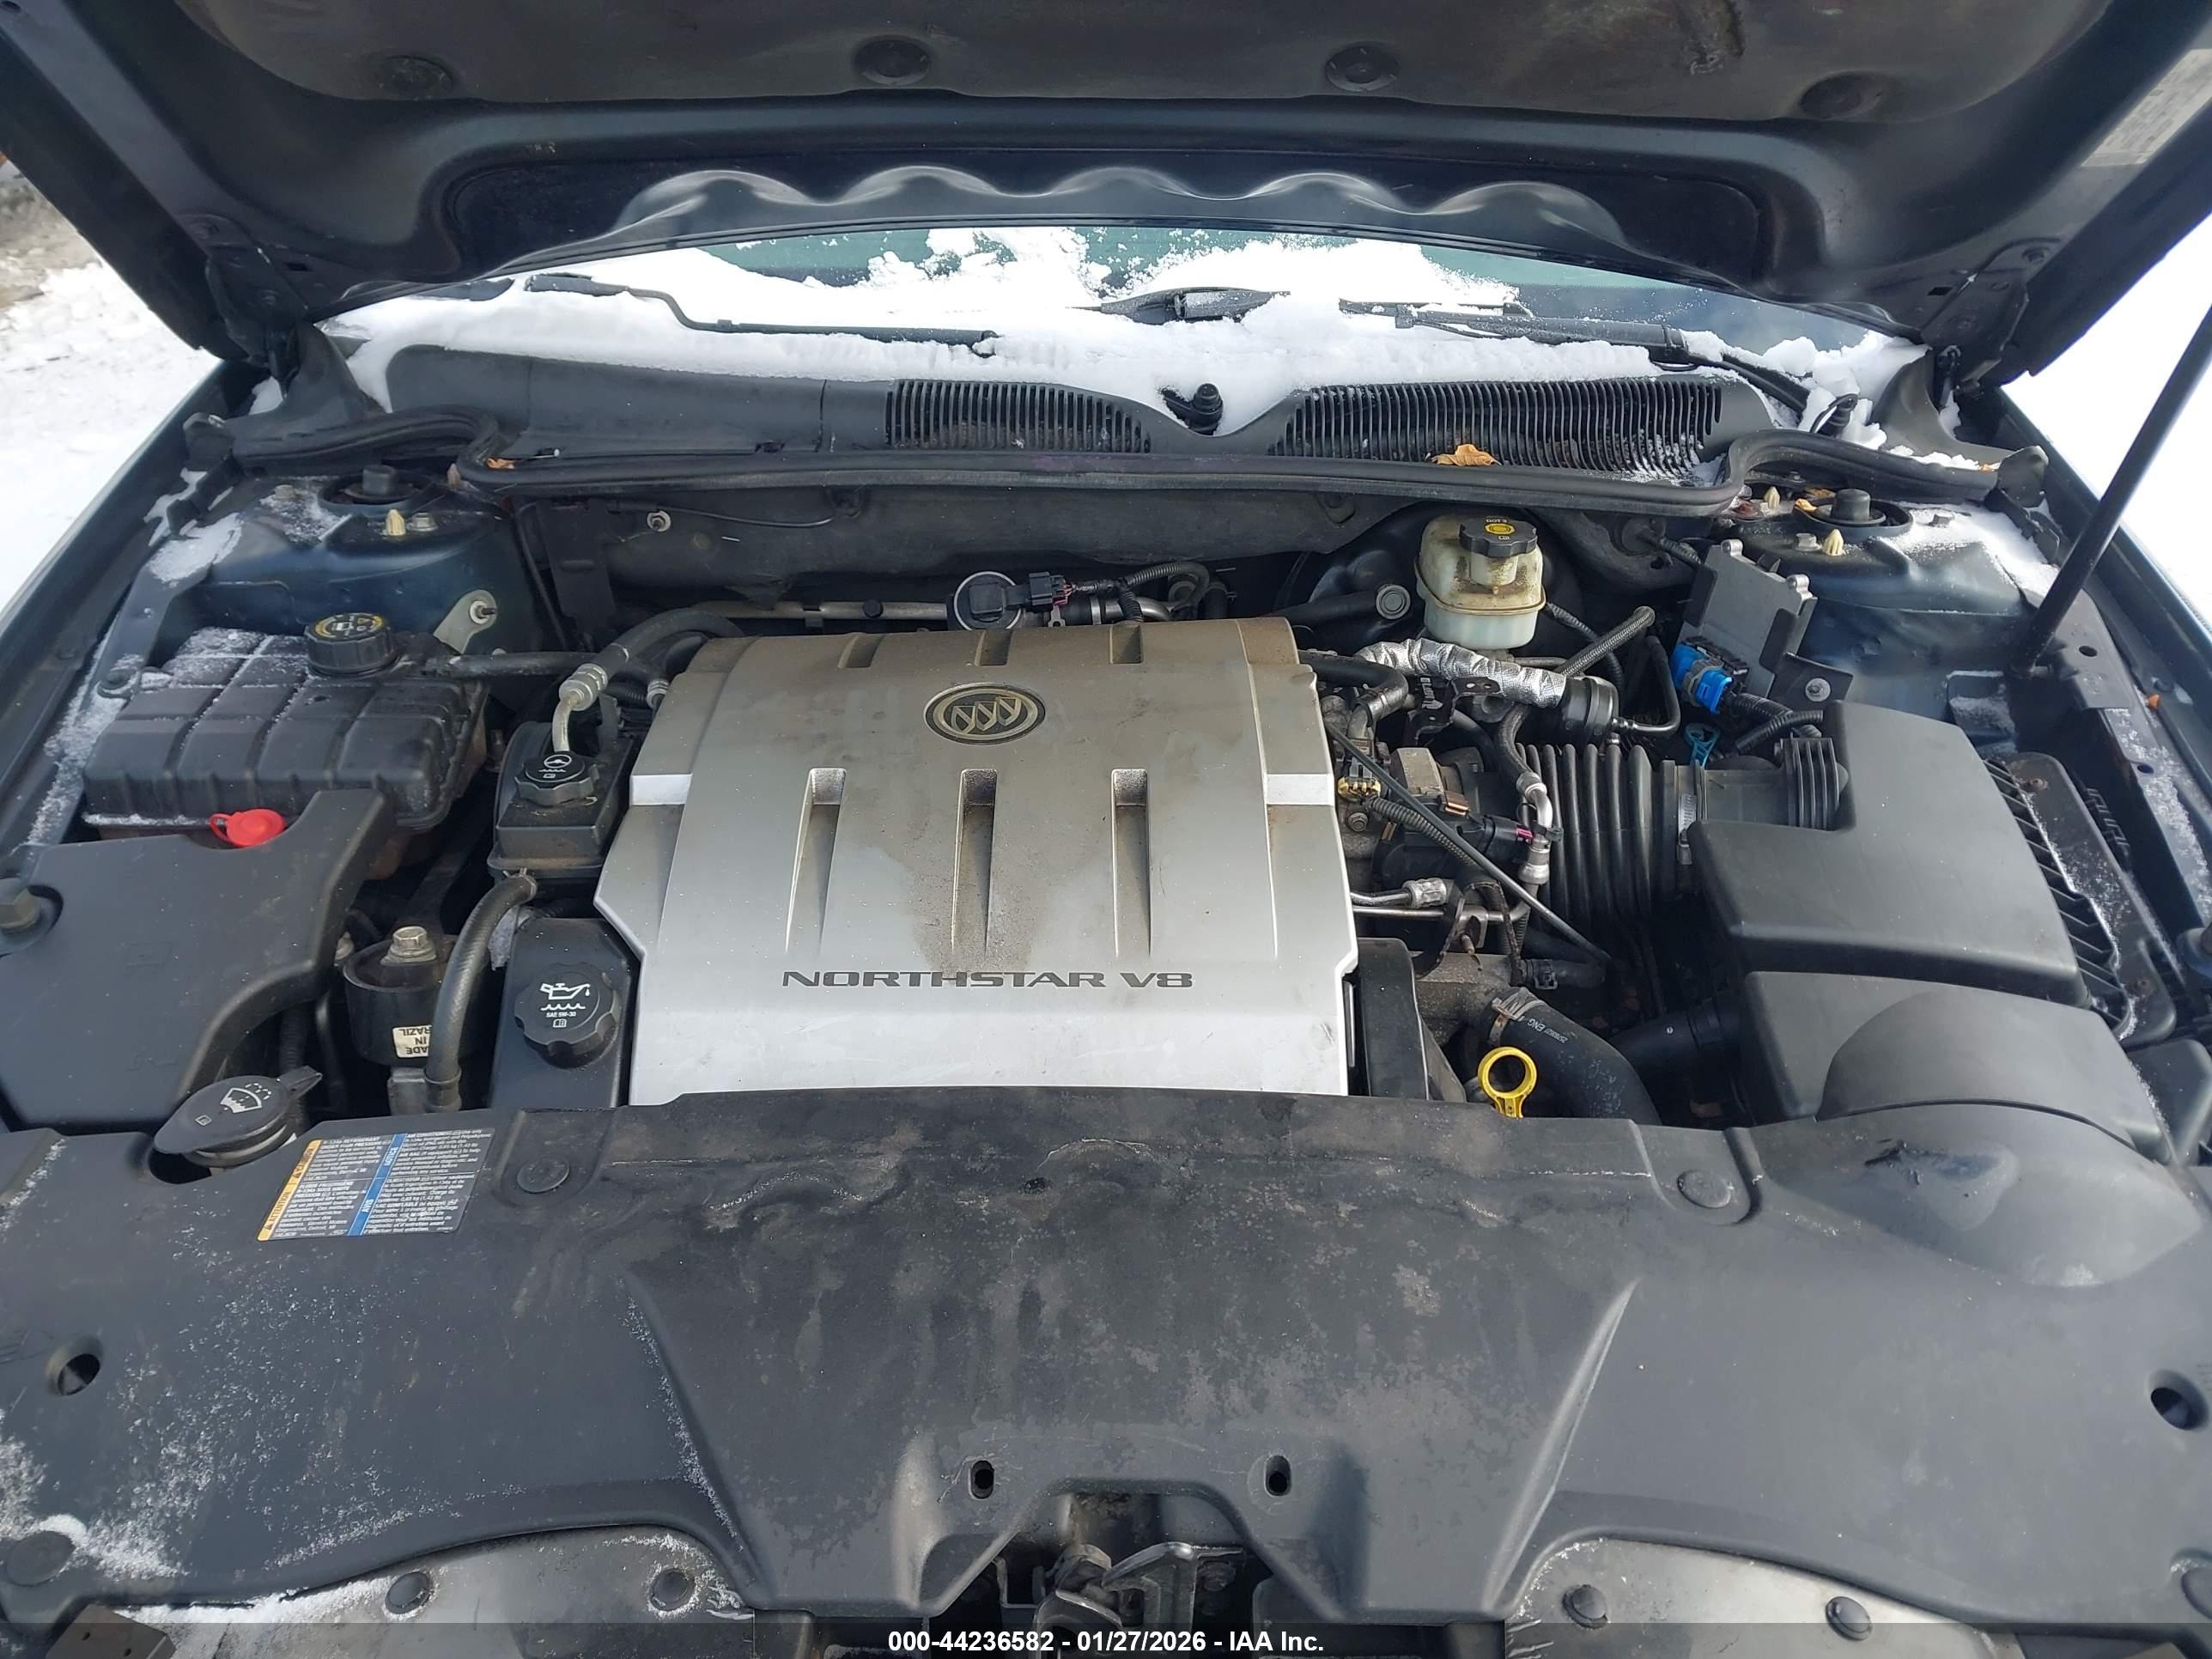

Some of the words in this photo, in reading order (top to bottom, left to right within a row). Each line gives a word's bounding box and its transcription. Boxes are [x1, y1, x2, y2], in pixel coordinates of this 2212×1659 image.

[782, 971, 1106, 988] NORTHSTAR
[1119, 971, 1193, 988] V8
[398, 1026, 433, 1036] RAZIL
[1527, 1018, 1546, 1032] ENG
[415, 1036, 427, 1045] IN
[405, 1046, 428, 1054] ADE
[383, 1146, 398, 1167] NOTICE
[362, 1198, 374, 1213] AVIS
